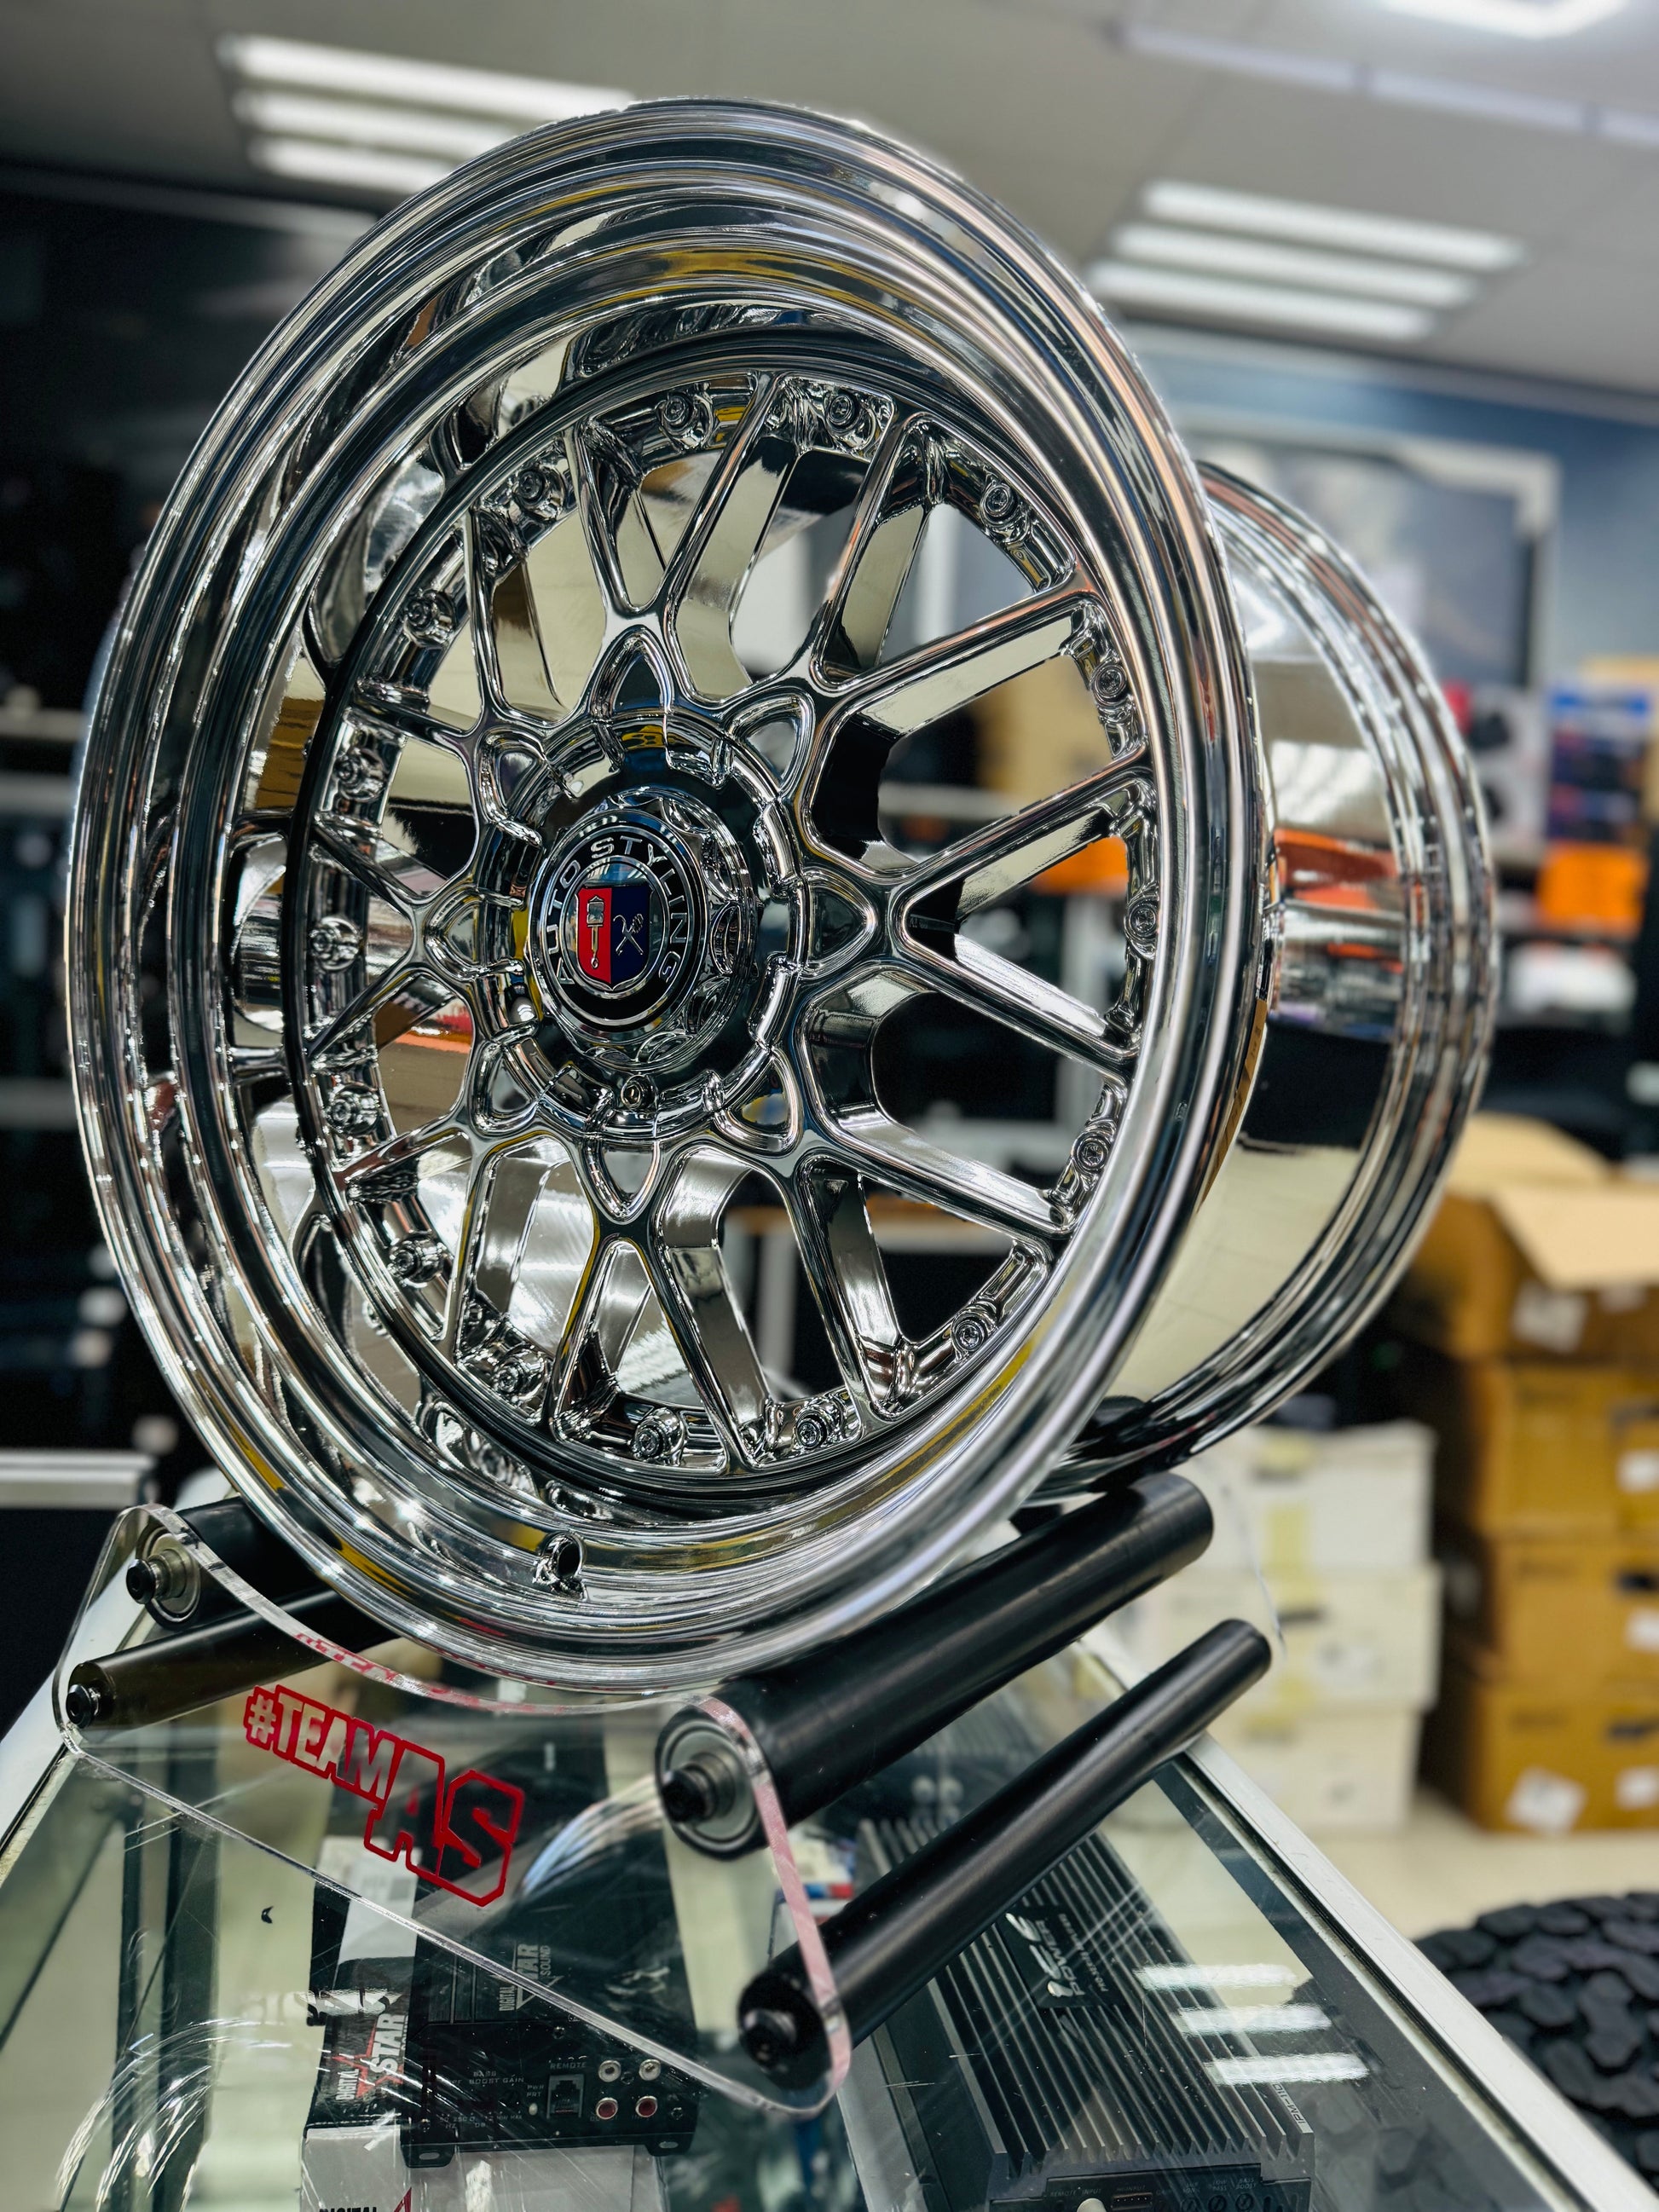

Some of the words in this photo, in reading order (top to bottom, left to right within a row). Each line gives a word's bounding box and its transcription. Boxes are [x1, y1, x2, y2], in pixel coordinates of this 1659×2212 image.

[546, 859, 581, 985] AUTO
[591, 835, 688, 982] STYLING
[243, 1684, 398, 1806] #TEAM
[540, 1945, 551, 1977] SOUND
[1035, 1920, 1086, 1995] POWER
[369, 2013, 405, 2075] STAR
[336, 2069, 359, 2100] DIGITAL
